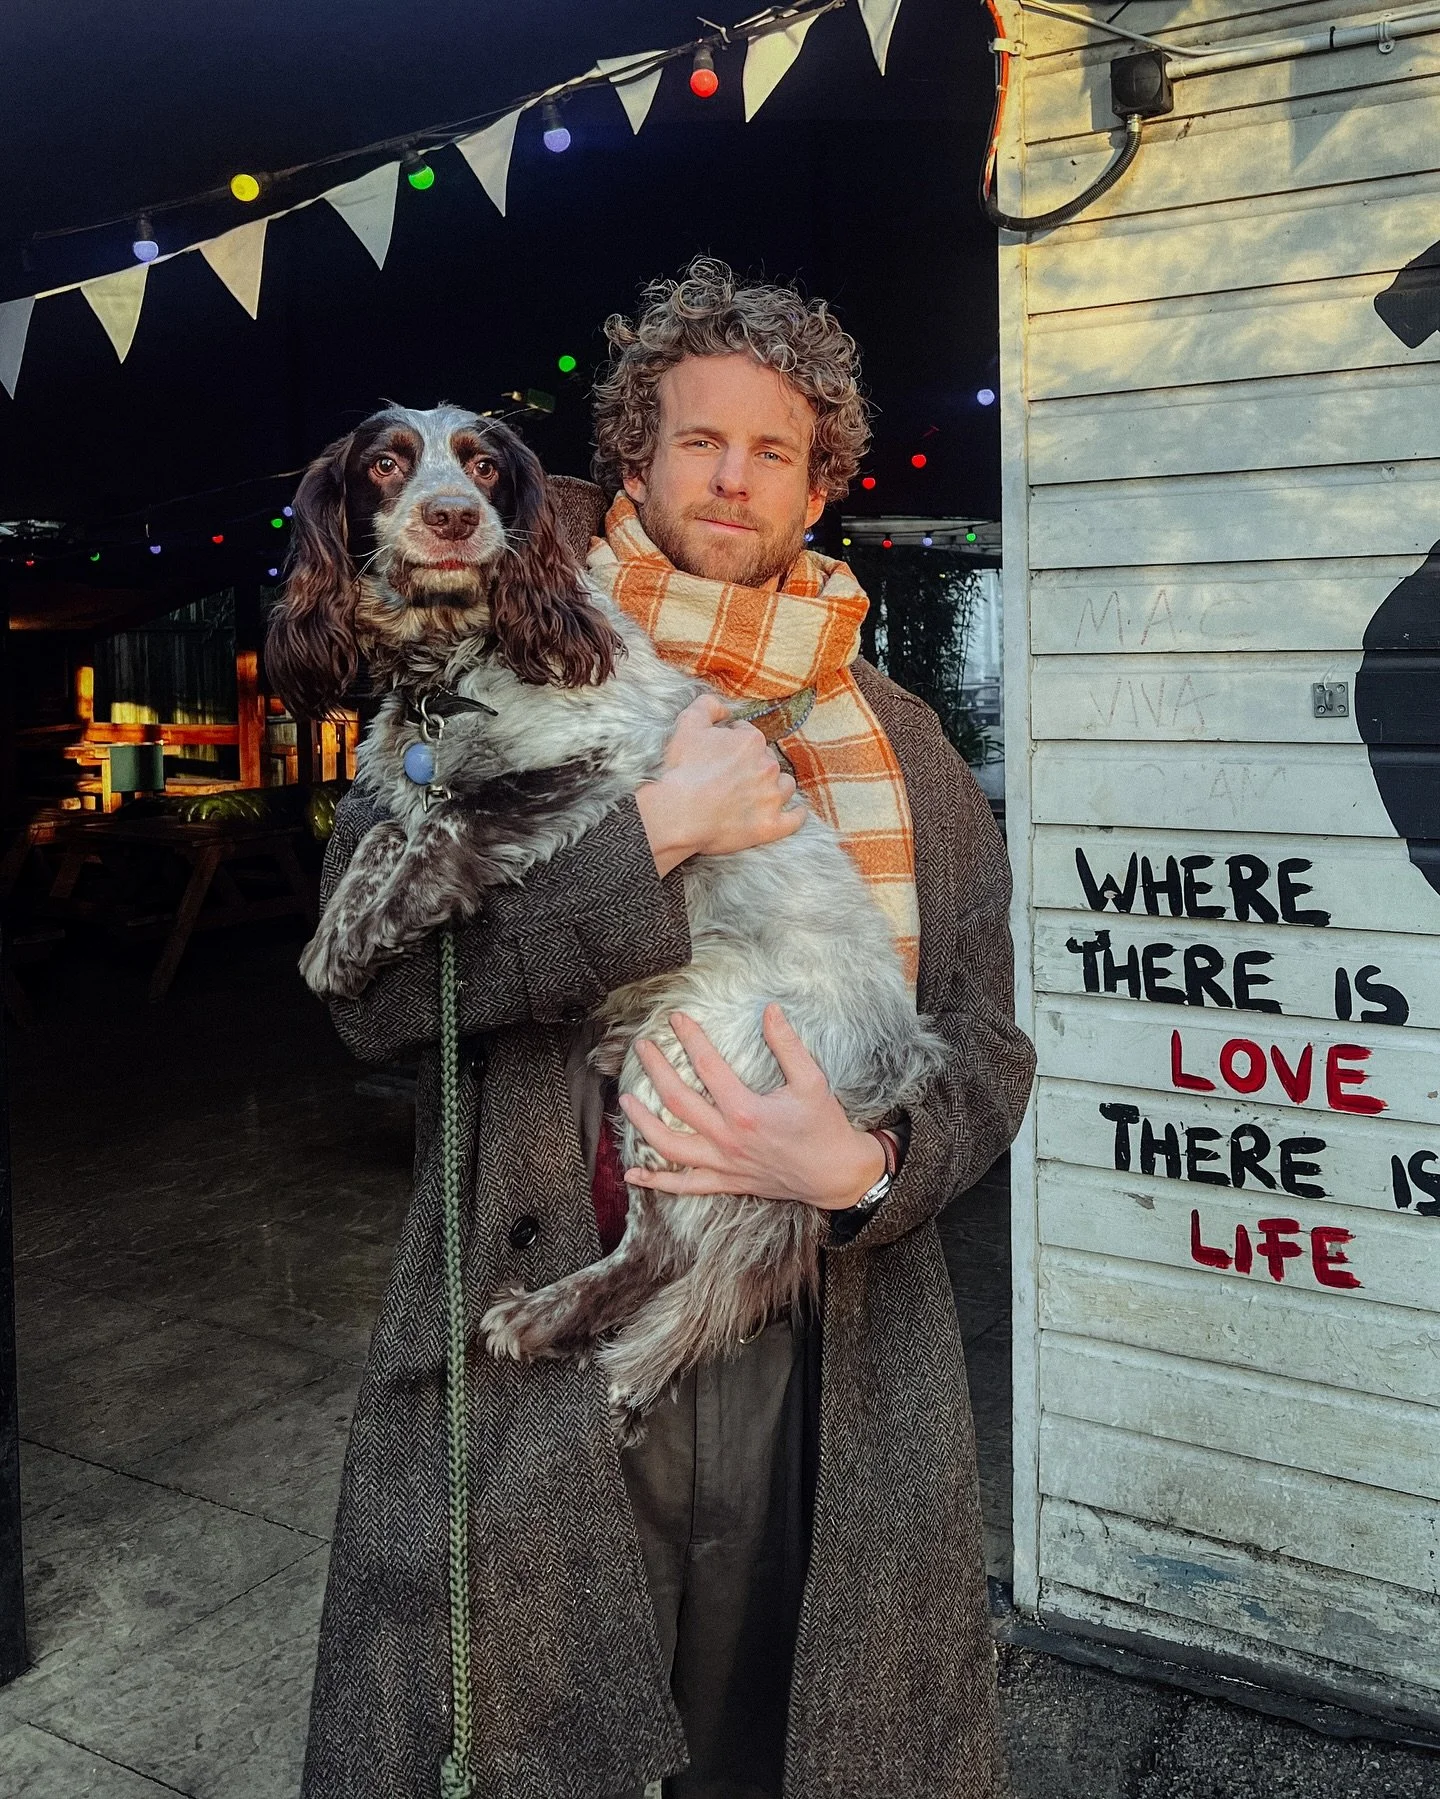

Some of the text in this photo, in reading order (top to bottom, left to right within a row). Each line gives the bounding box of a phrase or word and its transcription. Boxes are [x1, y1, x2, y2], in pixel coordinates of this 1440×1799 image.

[1075, 847, 1331, 927] WHERE
[1065, 929, 1410, 1026] THERE IS
[1170, 1029, 1388, 1115] LOVE
[1099, 1102, 1440, 1217] THERE IS
[1191, 1208, 1365, 1289] LIFE
